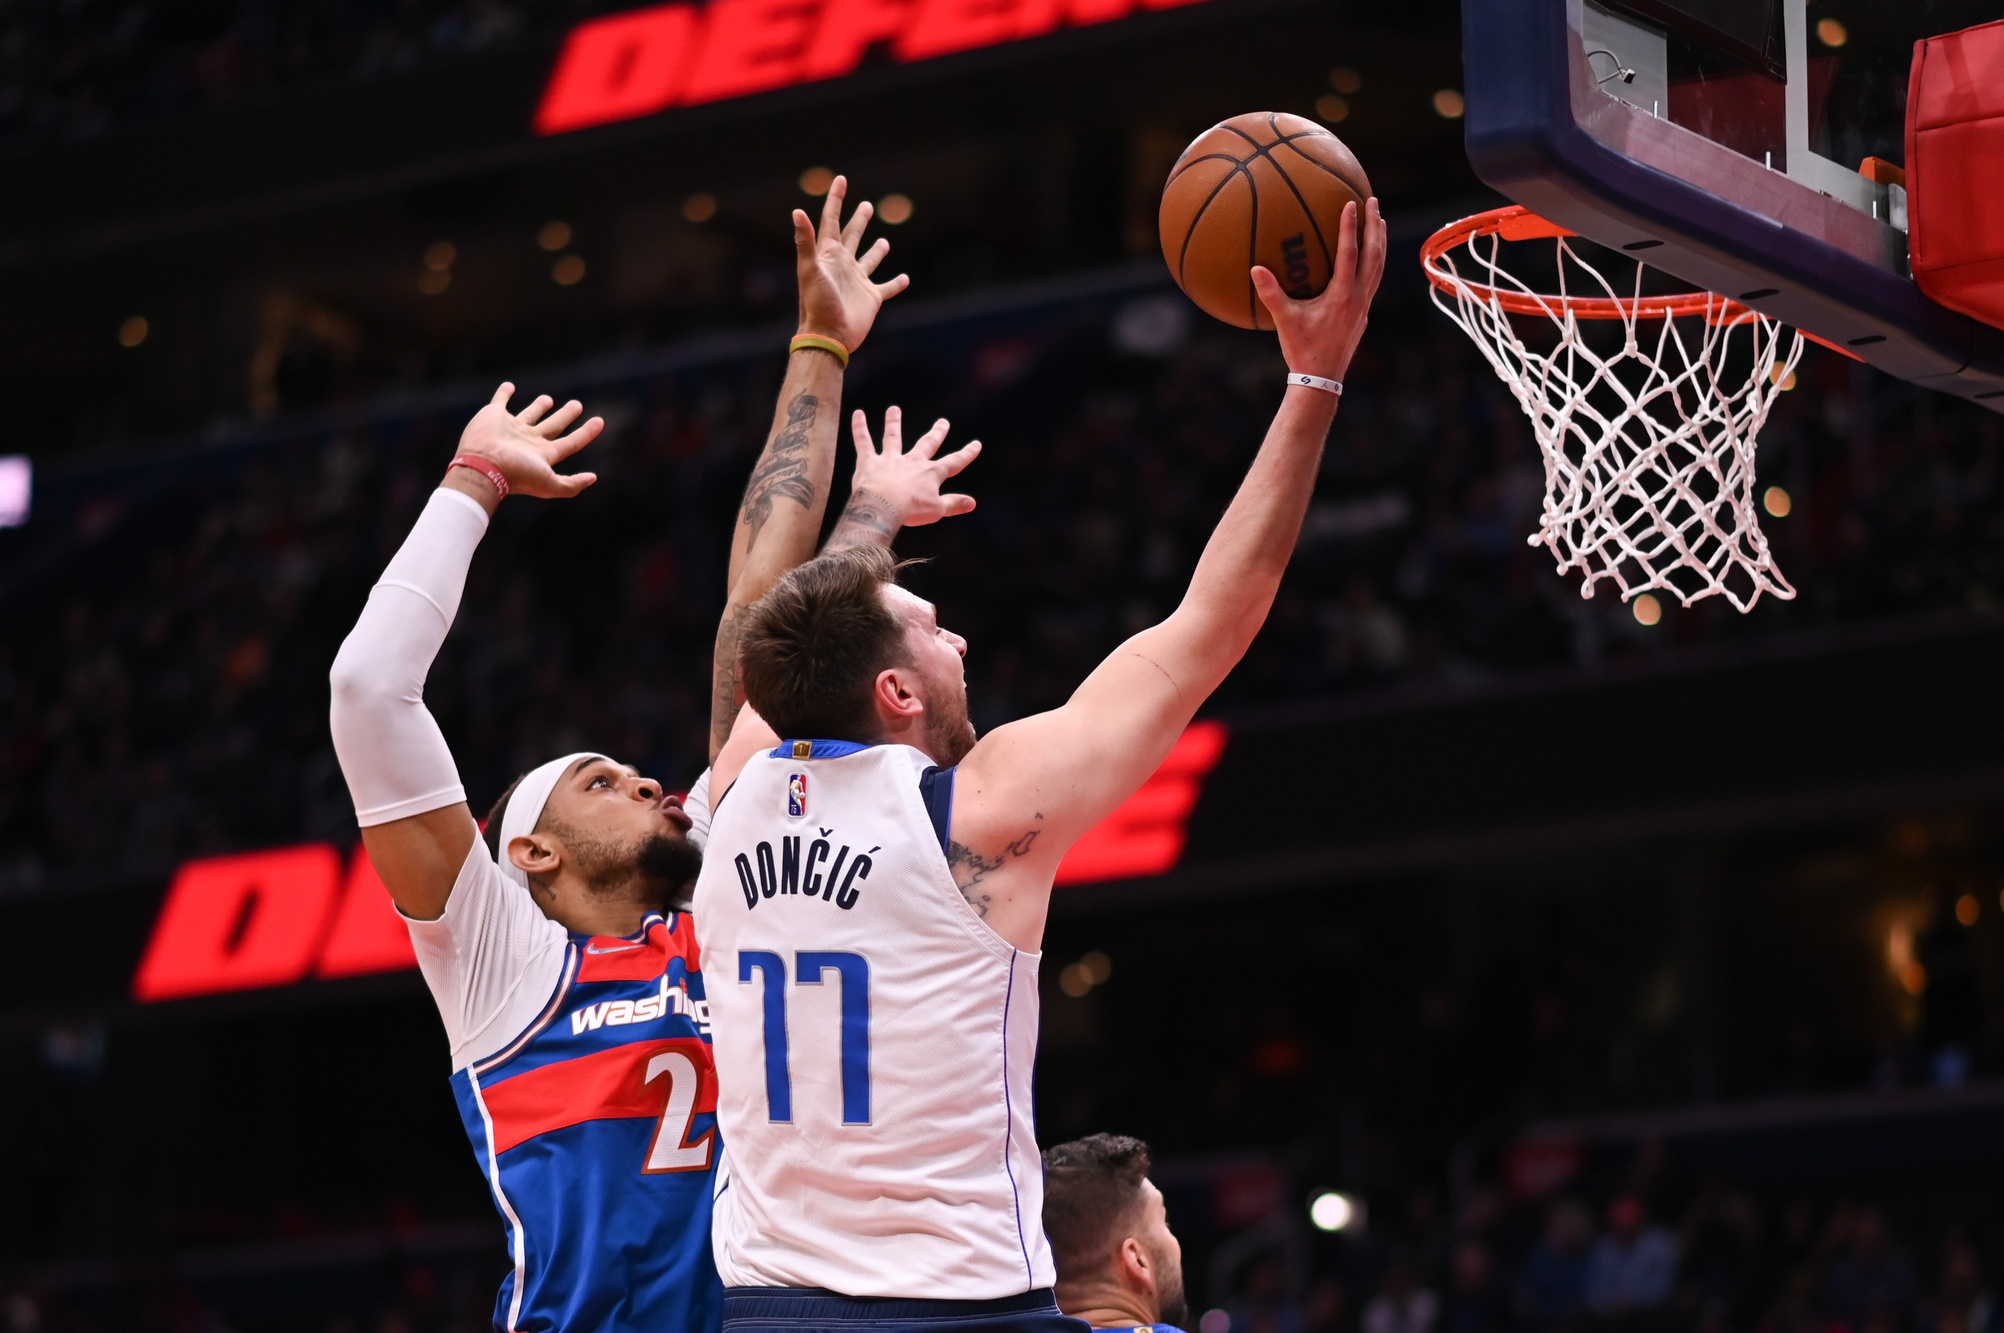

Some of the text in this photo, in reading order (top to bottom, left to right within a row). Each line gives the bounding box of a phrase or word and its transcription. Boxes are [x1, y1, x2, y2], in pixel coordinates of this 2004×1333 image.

[734, 827, 881, 911] DONČIĆ
[737, 948, 872, 1126] 77
[640, 1047, 718, 1175] 2
